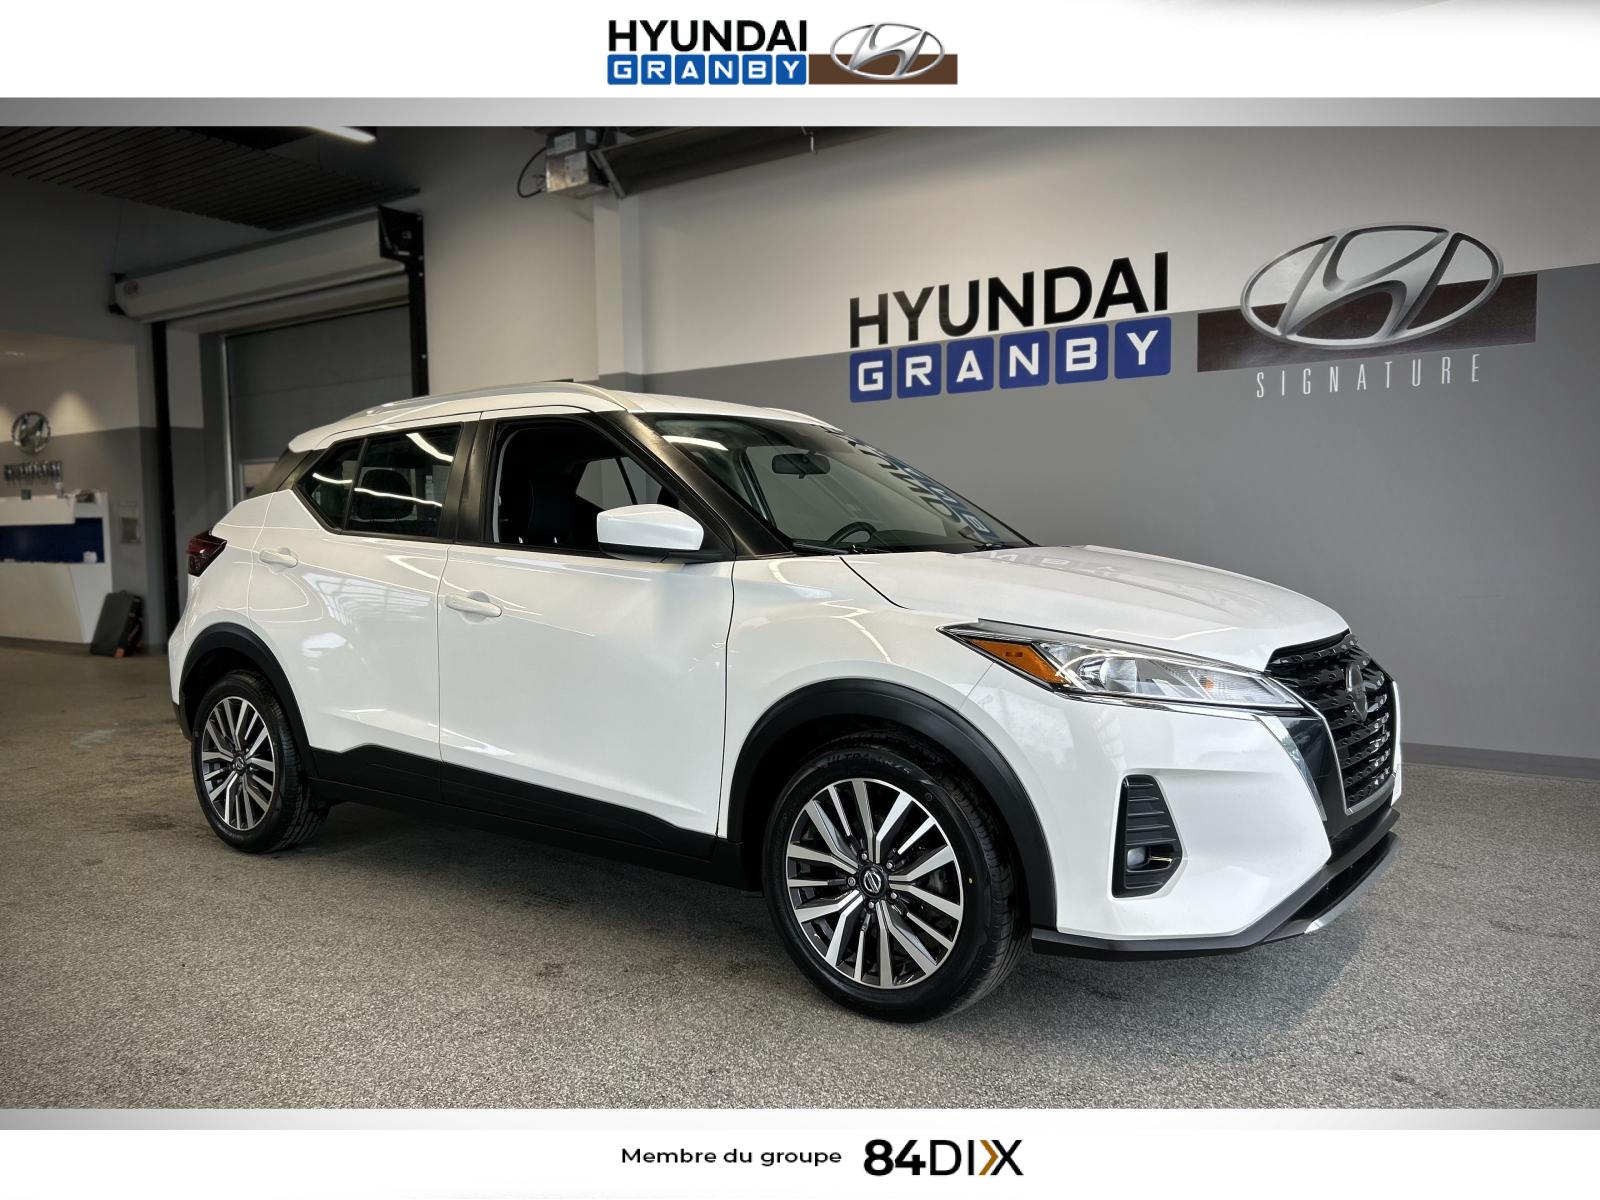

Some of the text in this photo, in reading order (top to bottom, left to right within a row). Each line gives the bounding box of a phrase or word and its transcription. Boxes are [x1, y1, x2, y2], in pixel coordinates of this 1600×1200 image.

[849, 251, 1169, 349] HYUNDAI
[856, 328, 1160, 393] GRANBY
[1256, 353, 1481, 399] SIGNATURE
